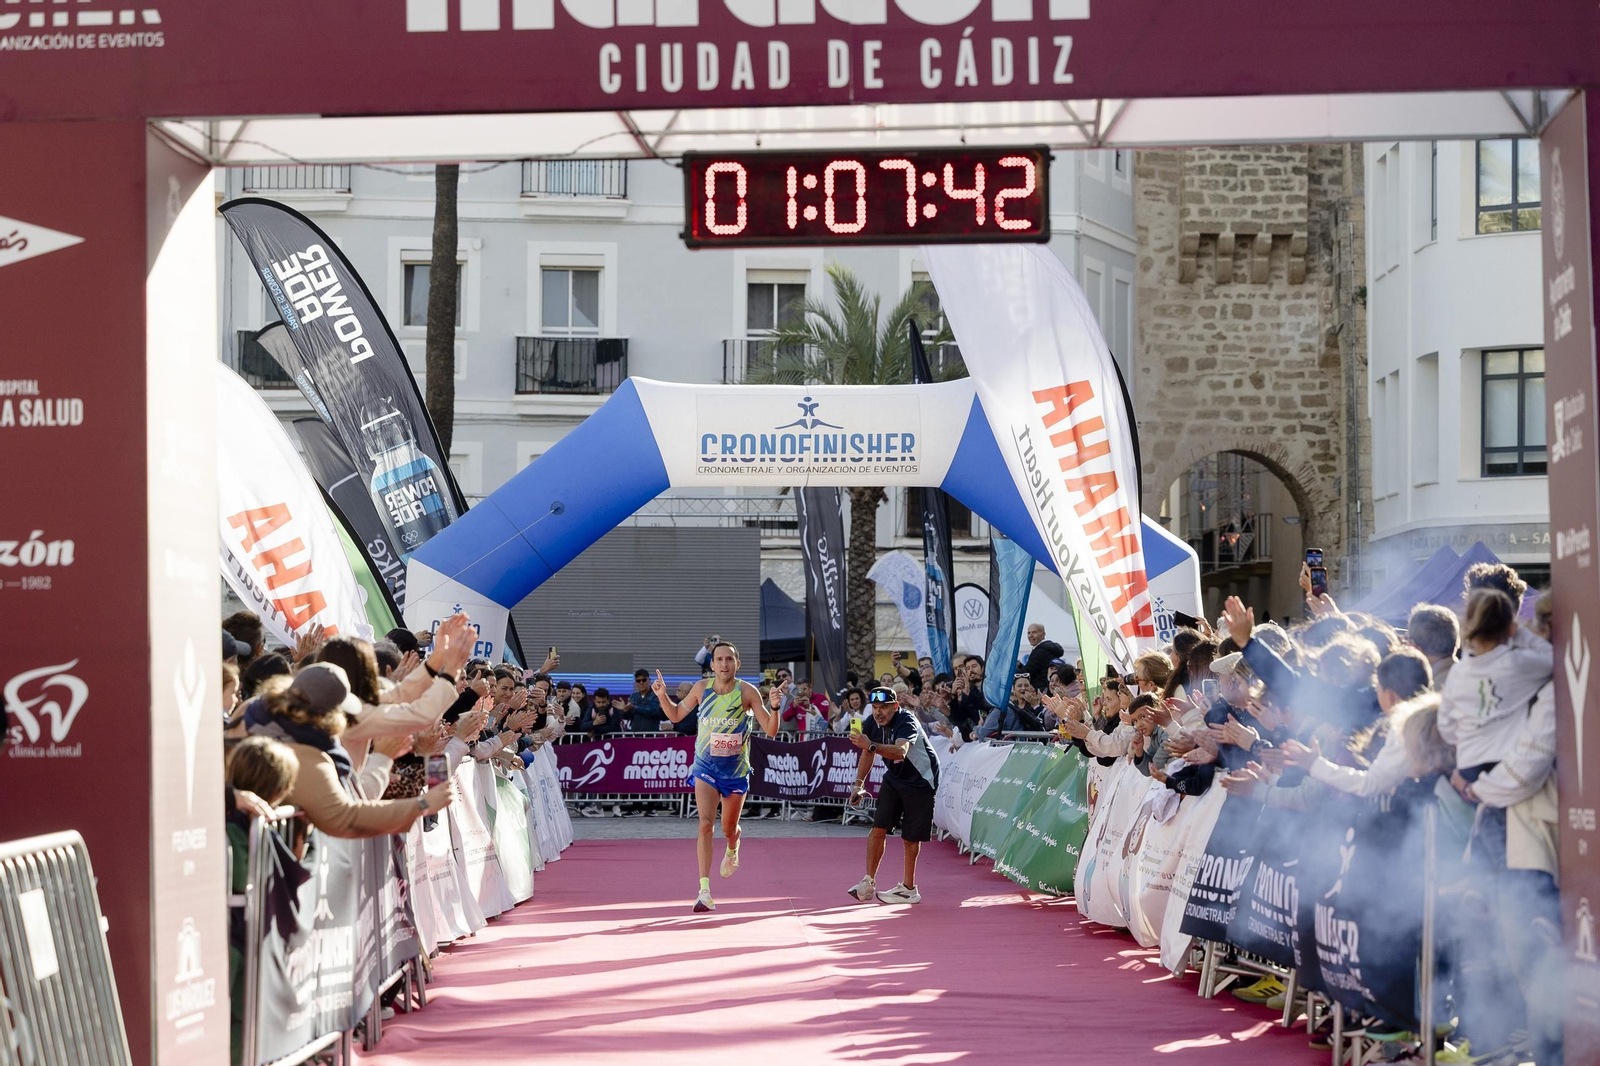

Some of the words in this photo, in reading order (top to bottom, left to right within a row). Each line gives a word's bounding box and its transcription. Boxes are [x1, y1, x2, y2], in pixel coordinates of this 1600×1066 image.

[77, 34, 96, 48] DE
[98, 32, 165, 48] EVENTOS
[600, 40, 791, 94] CIUDAD
[828, 39, 884, 89] DE
[920, 27, 1074, 89] CÁDIZ
[704, 157, 1036, 235] 01:07:42
[0, 398, 16, 427] A
[19, 398, 84, 427] SALUD
[701, 432, 916, 463] CRONOFINISHER
[697, 466, 775, 474] CRONOMETRAJE
[785, 465, 857, 474] ORGANIZACIÓN
[873, 465, 918, 473] EVENTOS
[709, 718, 739, 726] HYGGE
[46, 742, 82, 758] dental
[714, 739, 738, 749] 2563
[632, 747, 687, 765] media
[767, 753, 799, 771] media
[644, 780, 667, 788] CIUDAD
[669, 780, 677, 788] DE
